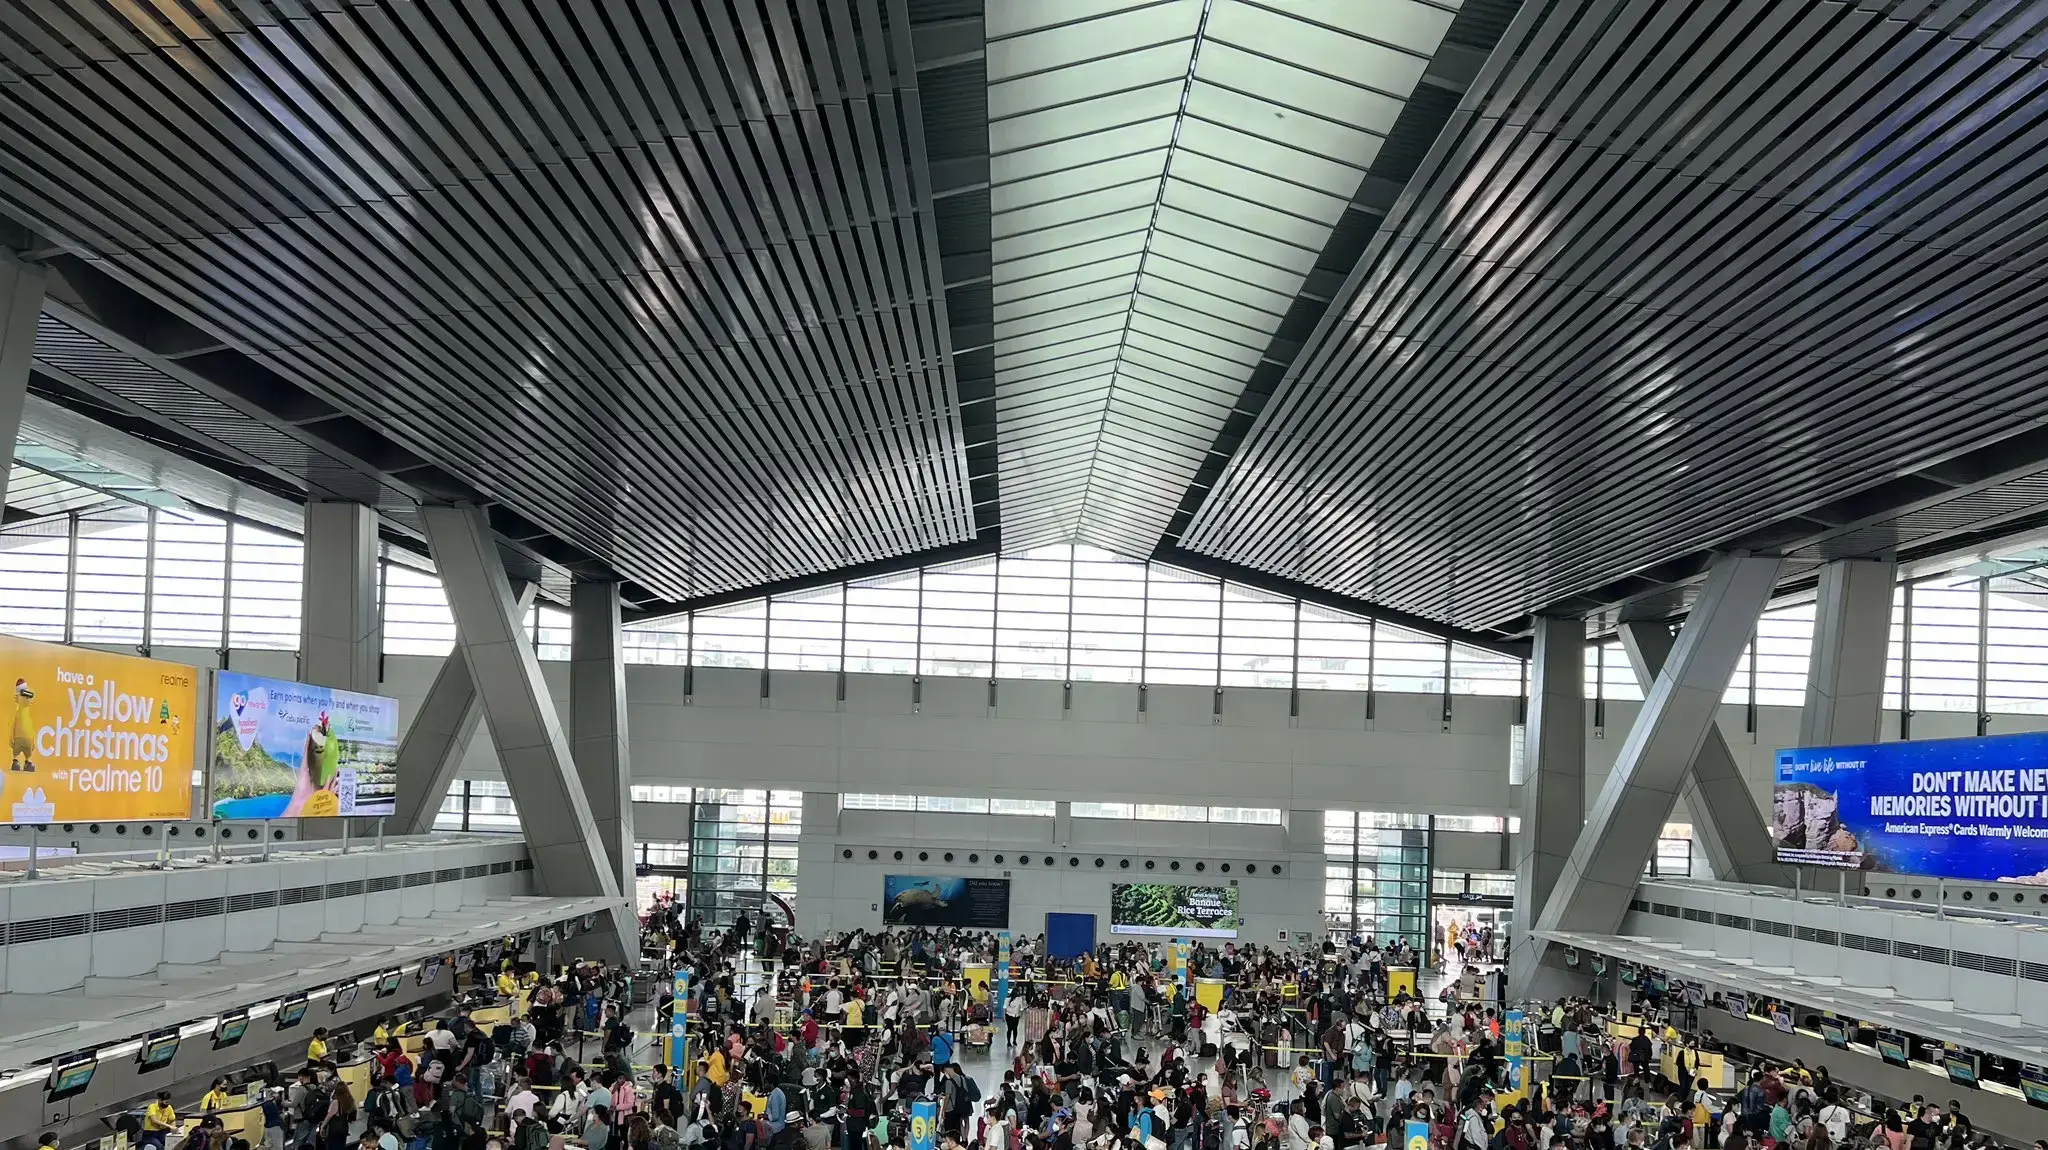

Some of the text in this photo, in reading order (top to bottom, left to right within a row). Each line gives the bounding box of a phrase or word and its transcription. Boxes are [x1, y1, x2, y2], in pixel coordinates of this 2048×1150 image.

[57, 667, 94, 686] have a
[160, 673, 189, 688] realme
[68, 680, 153, 728] yellow
[232, 694, 247, 710] go
[270, 690, 284, 700] Earn
[285, 692, 302, 704] points
[303, 695, 317, 705] when
[317, 697, 328, 708] you
[336, 700, 345, 709] and
[346, 701, 359, 711] when
[359, 704, 369, 714] you
[369, 704, 380, 715] shop
[36, 715, 169, 762] christmas
[1794, 763, 1809, 771] DON'T
[1835, 761, 1859, 770] WITHOUT
[52, 764, 163, 793] with realme 10
[1913, 771, 1962, 793] DON'T
[1964, 769, 2015, 793] MAKE
[1871, 795, 1952, 817] MEMORIES
[1954, 795, 2038, 818] WITHOUT
[1884, 822, 1918, 834] American
[1954, 824, 1977, 836] Cards
[1979, 824, 2011, 839] Warmly
[1189, 898, 1221, 907] Banaue
[1177, 906, 1195, 915] Rice
[1196, 906, 1233, 917] Terraces
[677, 984, 683, 993] 2
[916, 1126, 922, 1140] 3
